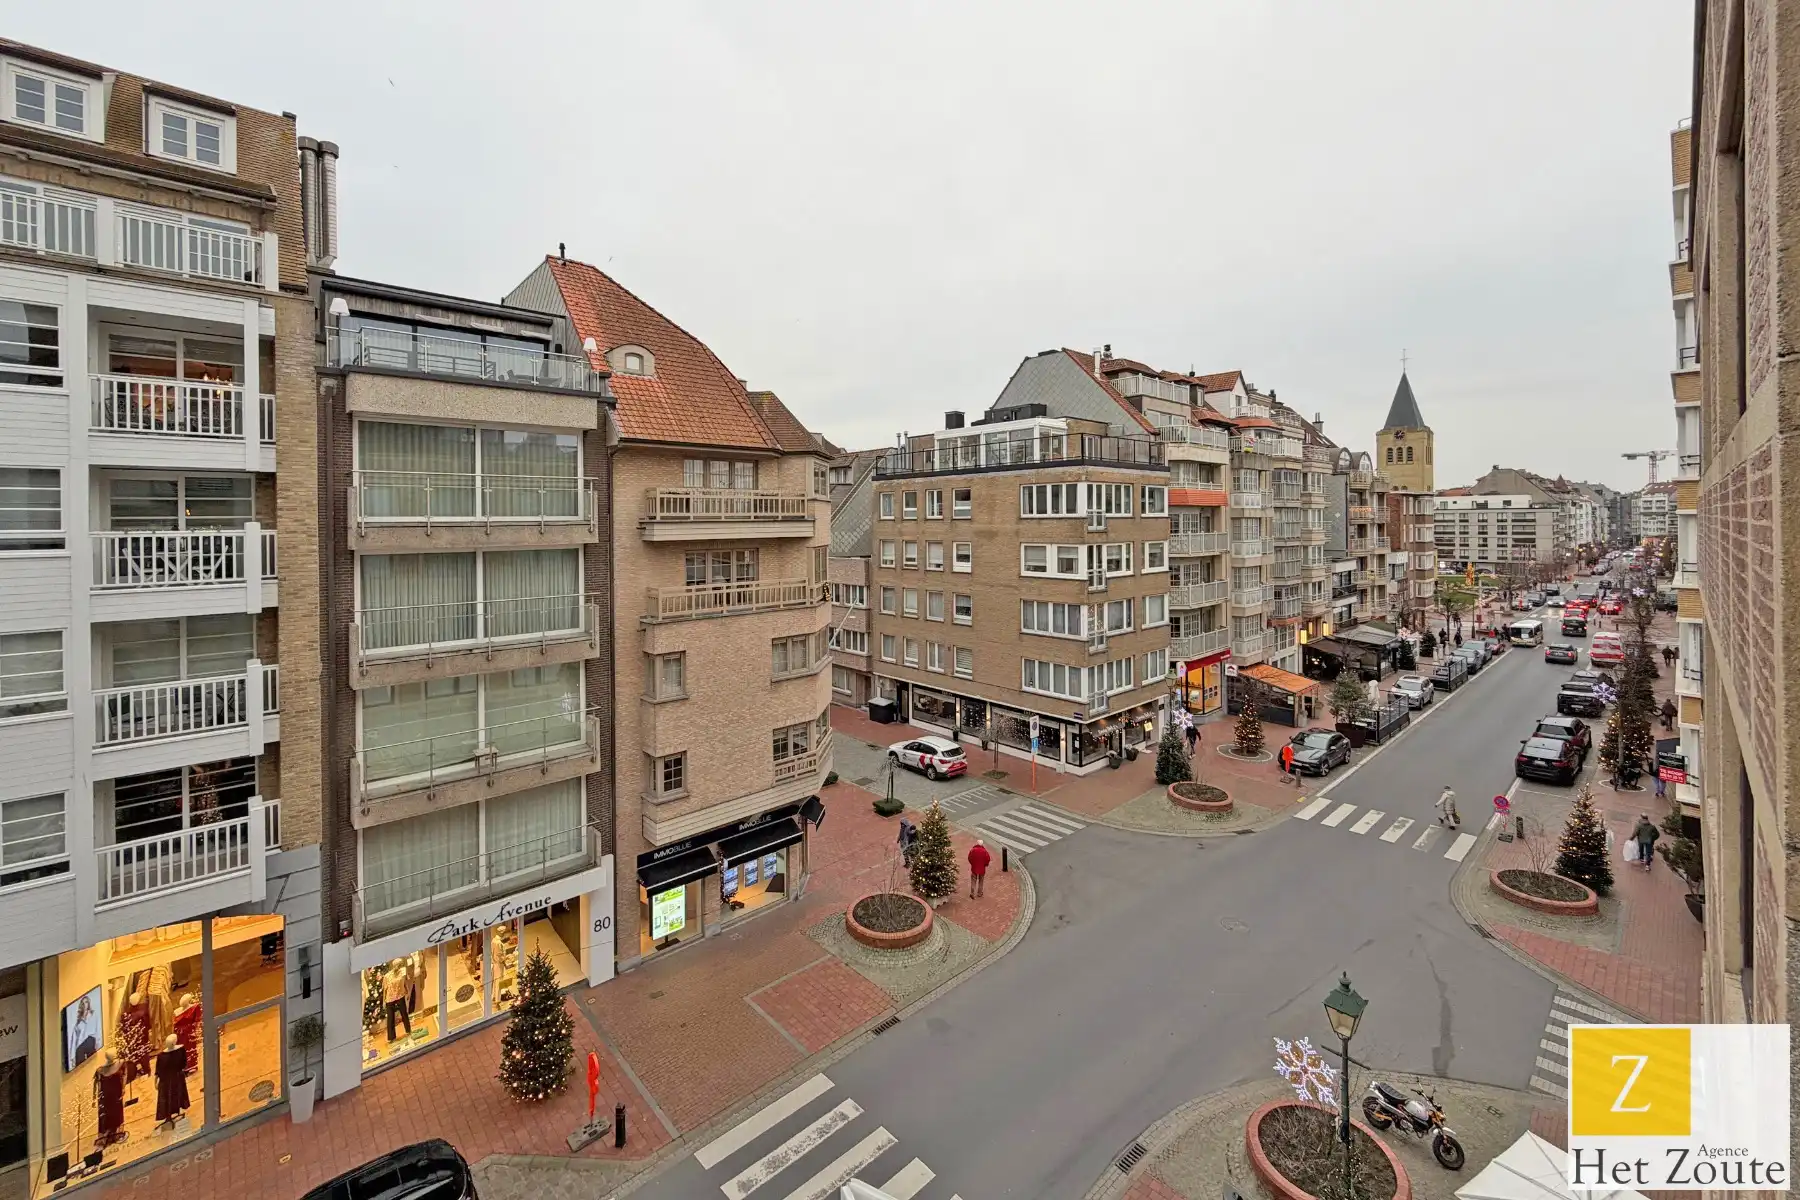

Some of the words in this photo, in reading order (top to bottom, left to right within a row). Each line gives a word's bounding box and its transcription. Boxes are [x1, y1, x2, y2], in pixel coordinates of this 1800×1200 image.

[739, 814, 772, 831] IMMOBLUE
[653, 841, 692, 859] IMMOBLUE
[427, 920, 480, 944] Park
[484, 896, 552, 927] Avenue
[594, 916, 610, 932] 80
